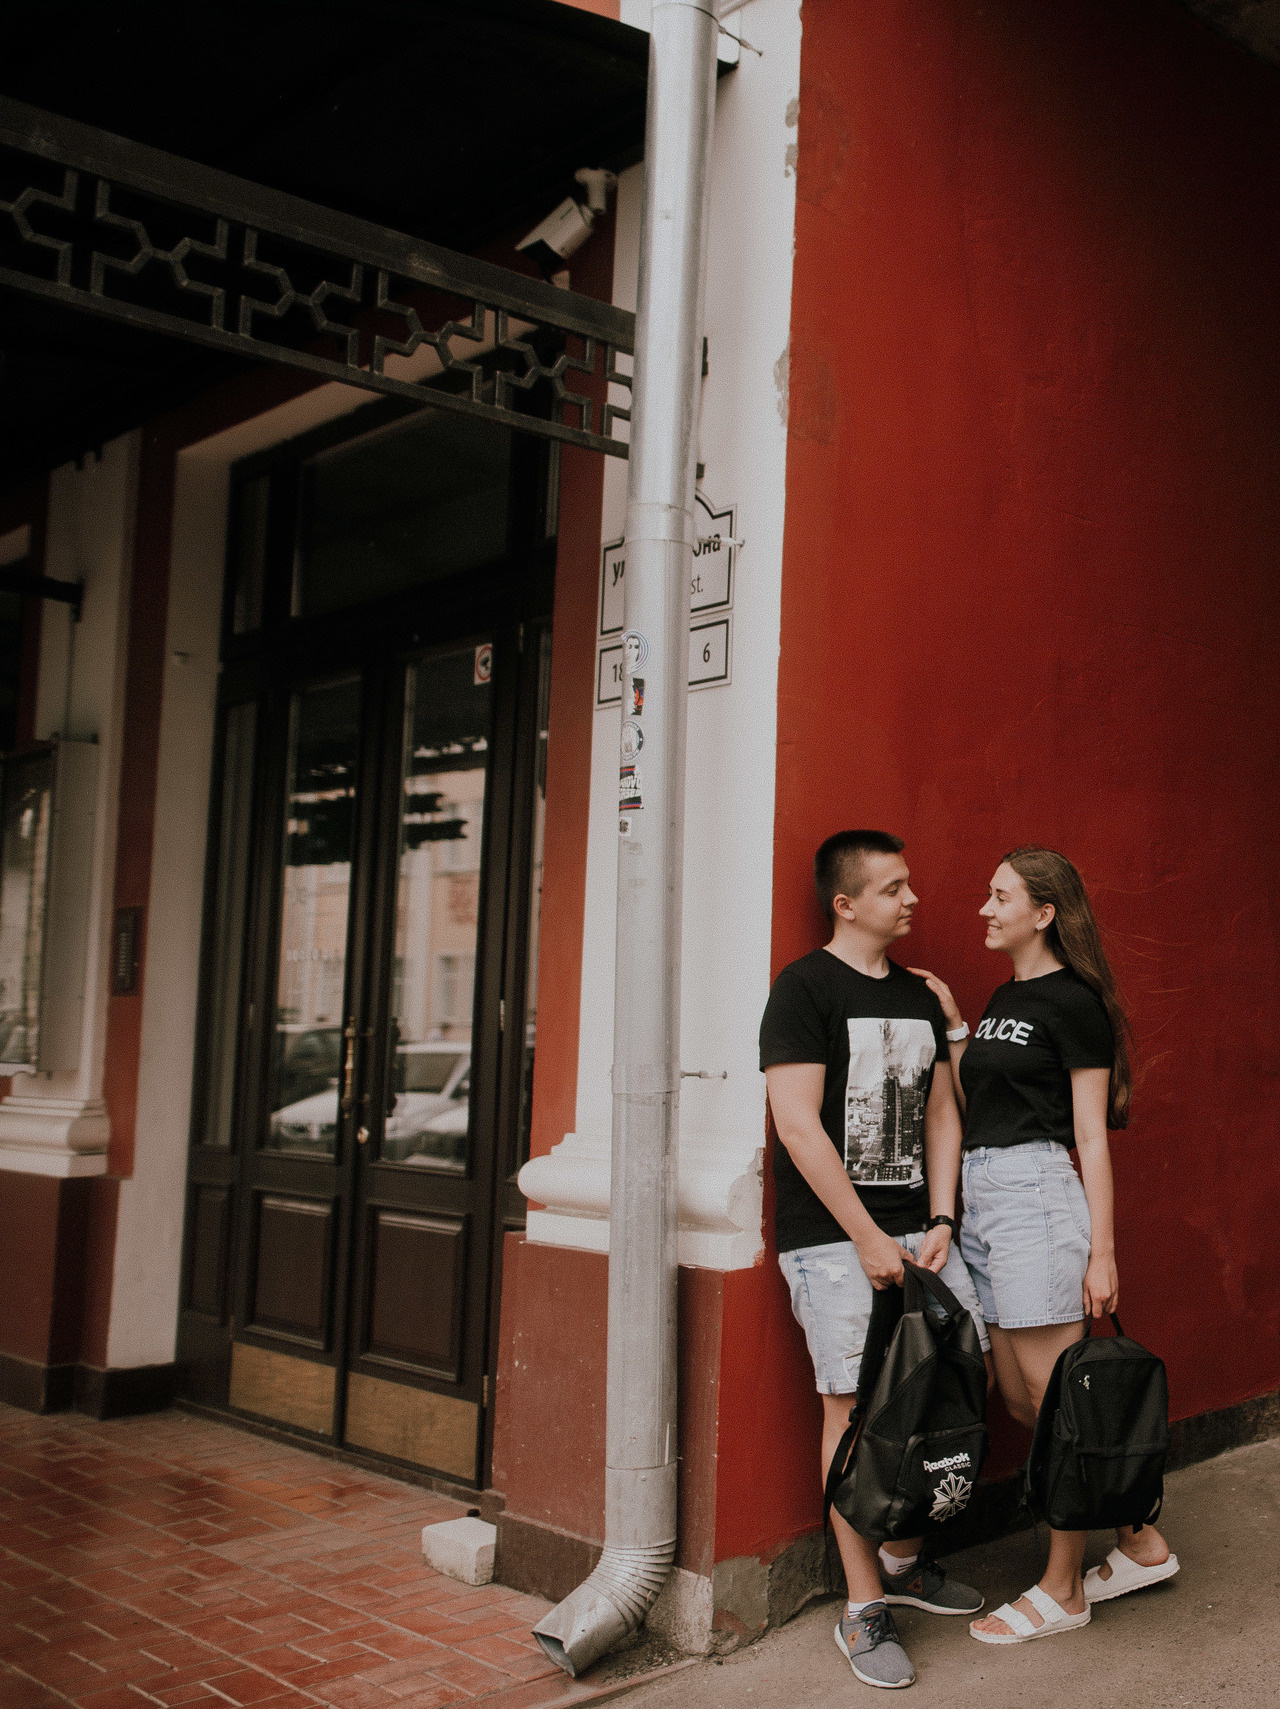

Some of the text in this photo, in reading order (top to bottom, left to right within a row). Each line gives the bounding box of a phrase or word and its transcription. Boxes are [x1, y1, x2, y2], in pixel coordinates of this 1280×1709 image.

[703, 642, 710, 663] 6
[923, 1452, 970, 1473] Reebok
[944, 1461, 972, 1472] CLASSIC
